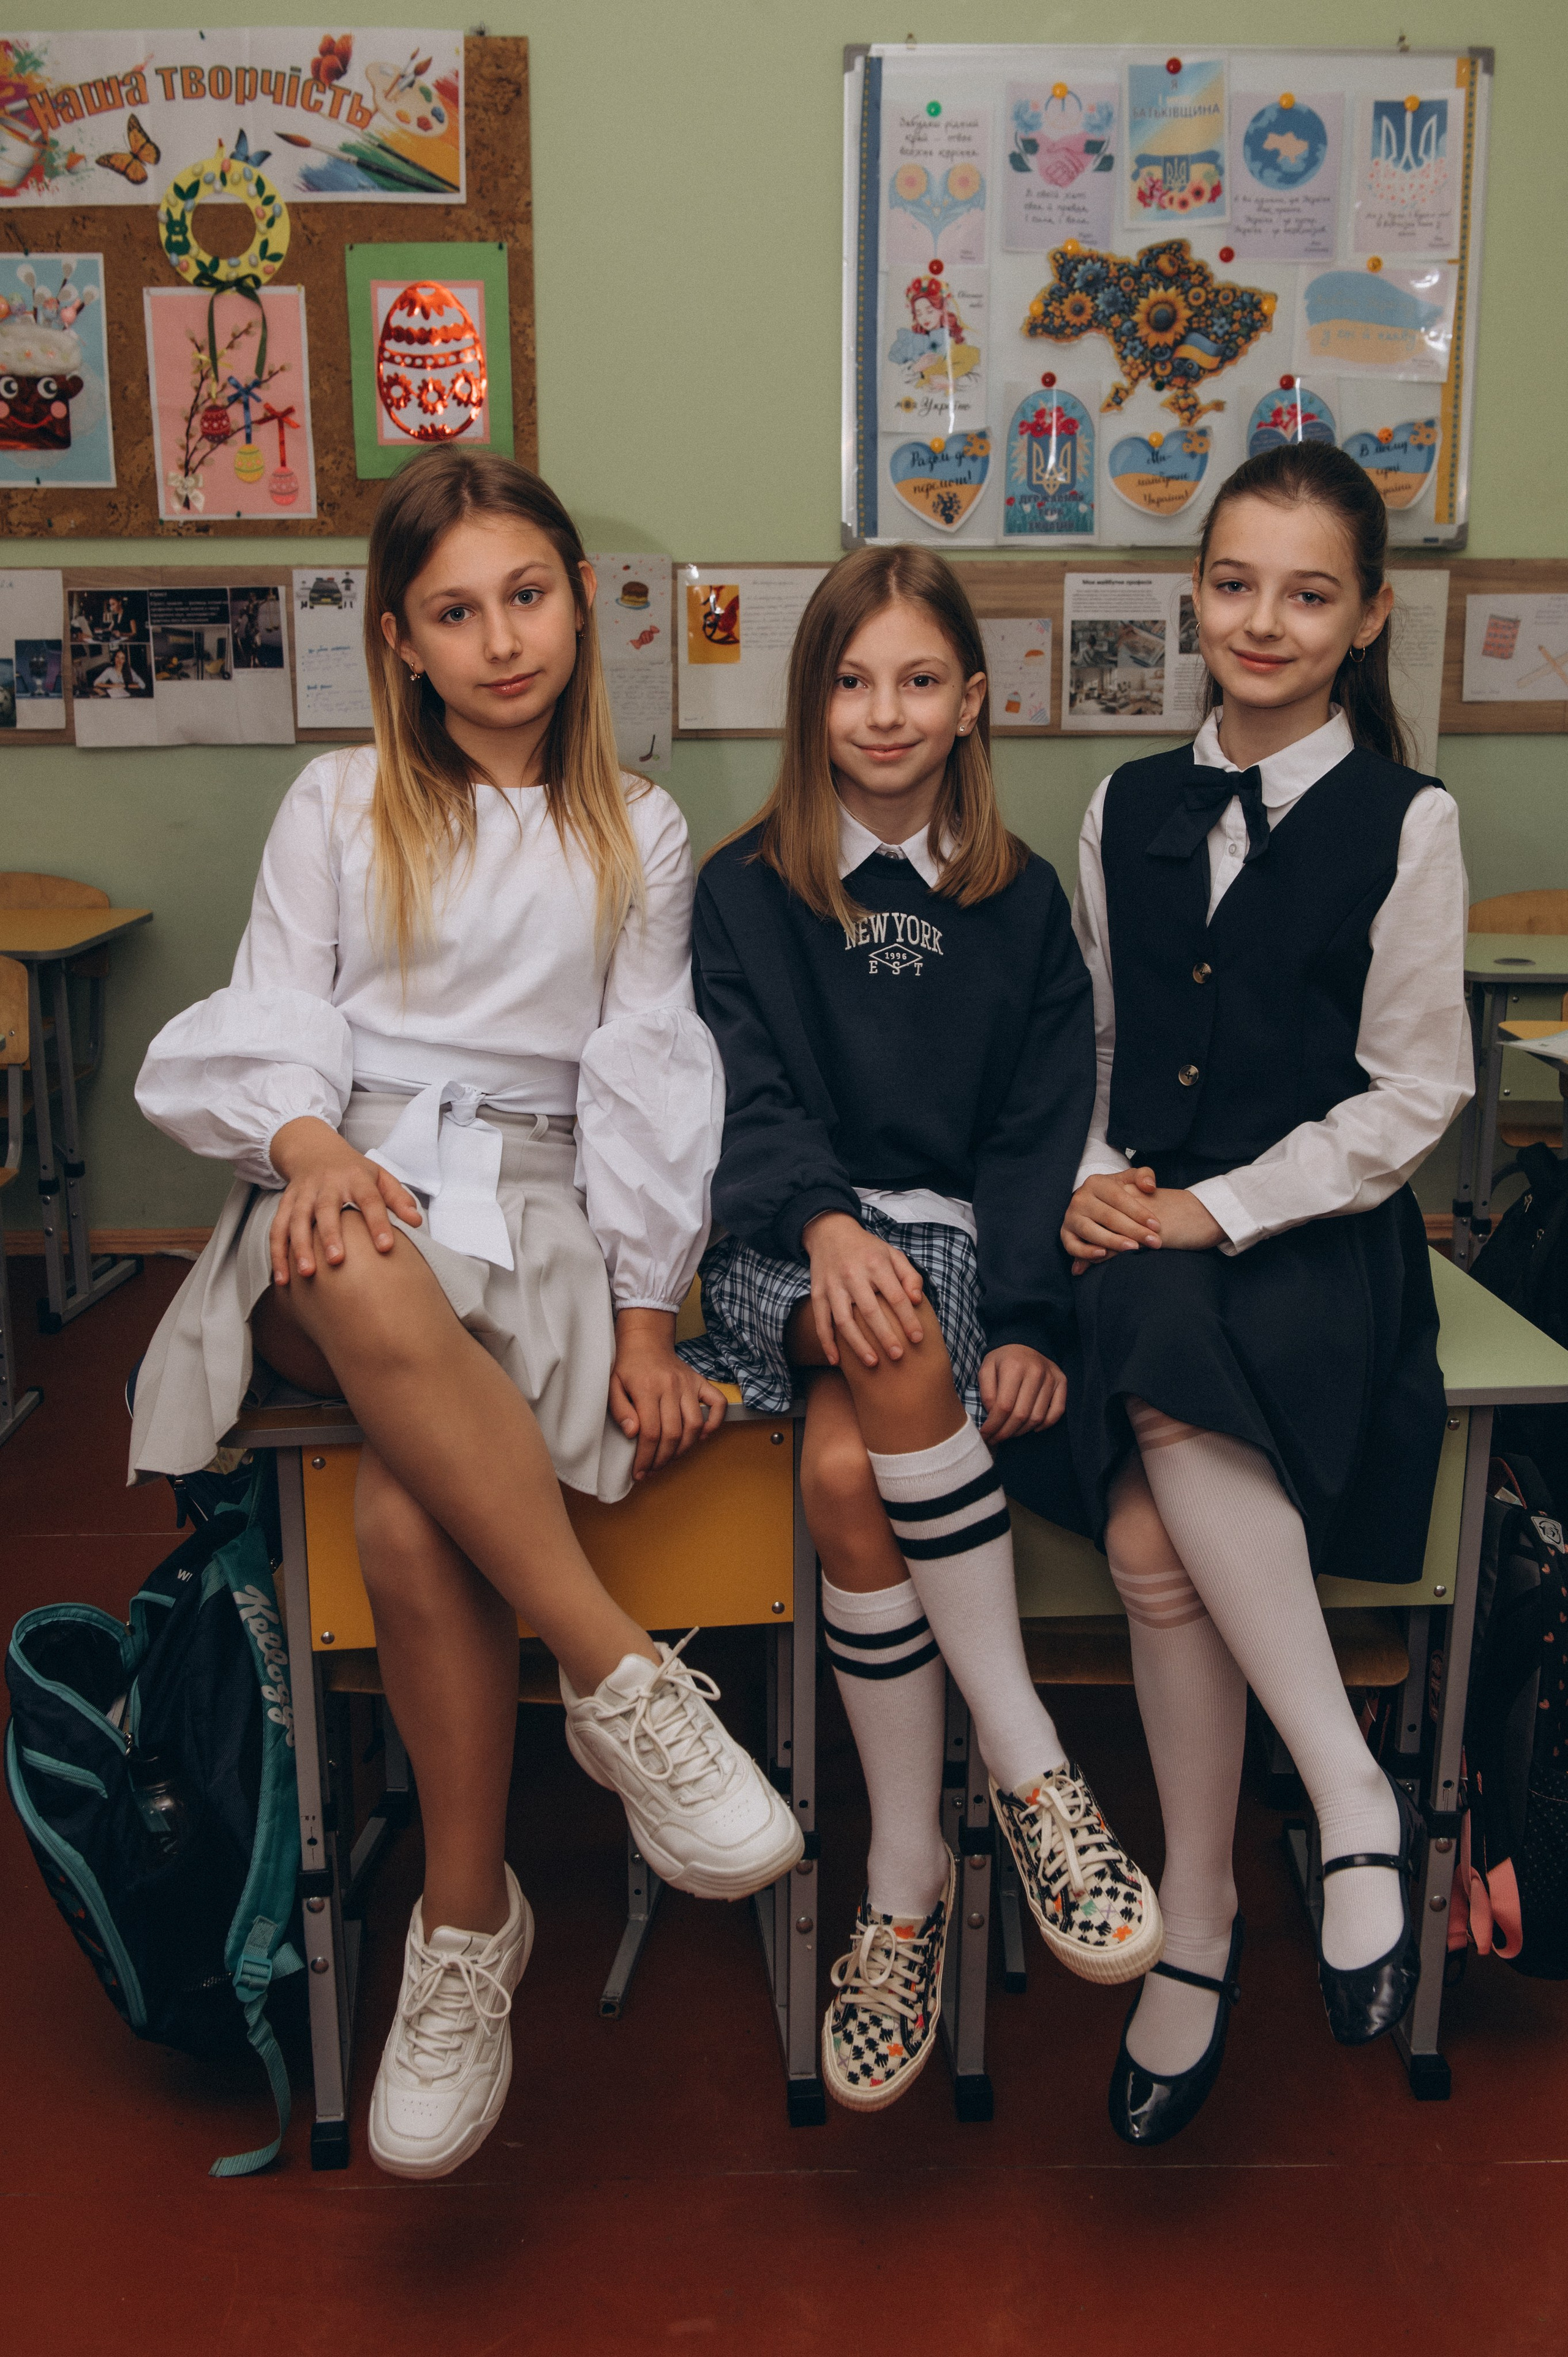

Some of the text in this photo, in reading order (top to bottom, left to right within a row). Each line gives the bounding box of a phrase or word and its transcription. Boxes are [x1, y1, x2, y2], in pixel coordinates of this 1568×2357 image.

[155, 65, 374, 130] творчість
[1133, 103, 1219, 119] БАТЬКІВЩИНА
[843, 912, 944, 956] NEW YORK
[233, 1585, 295, 1748] Kellogg
